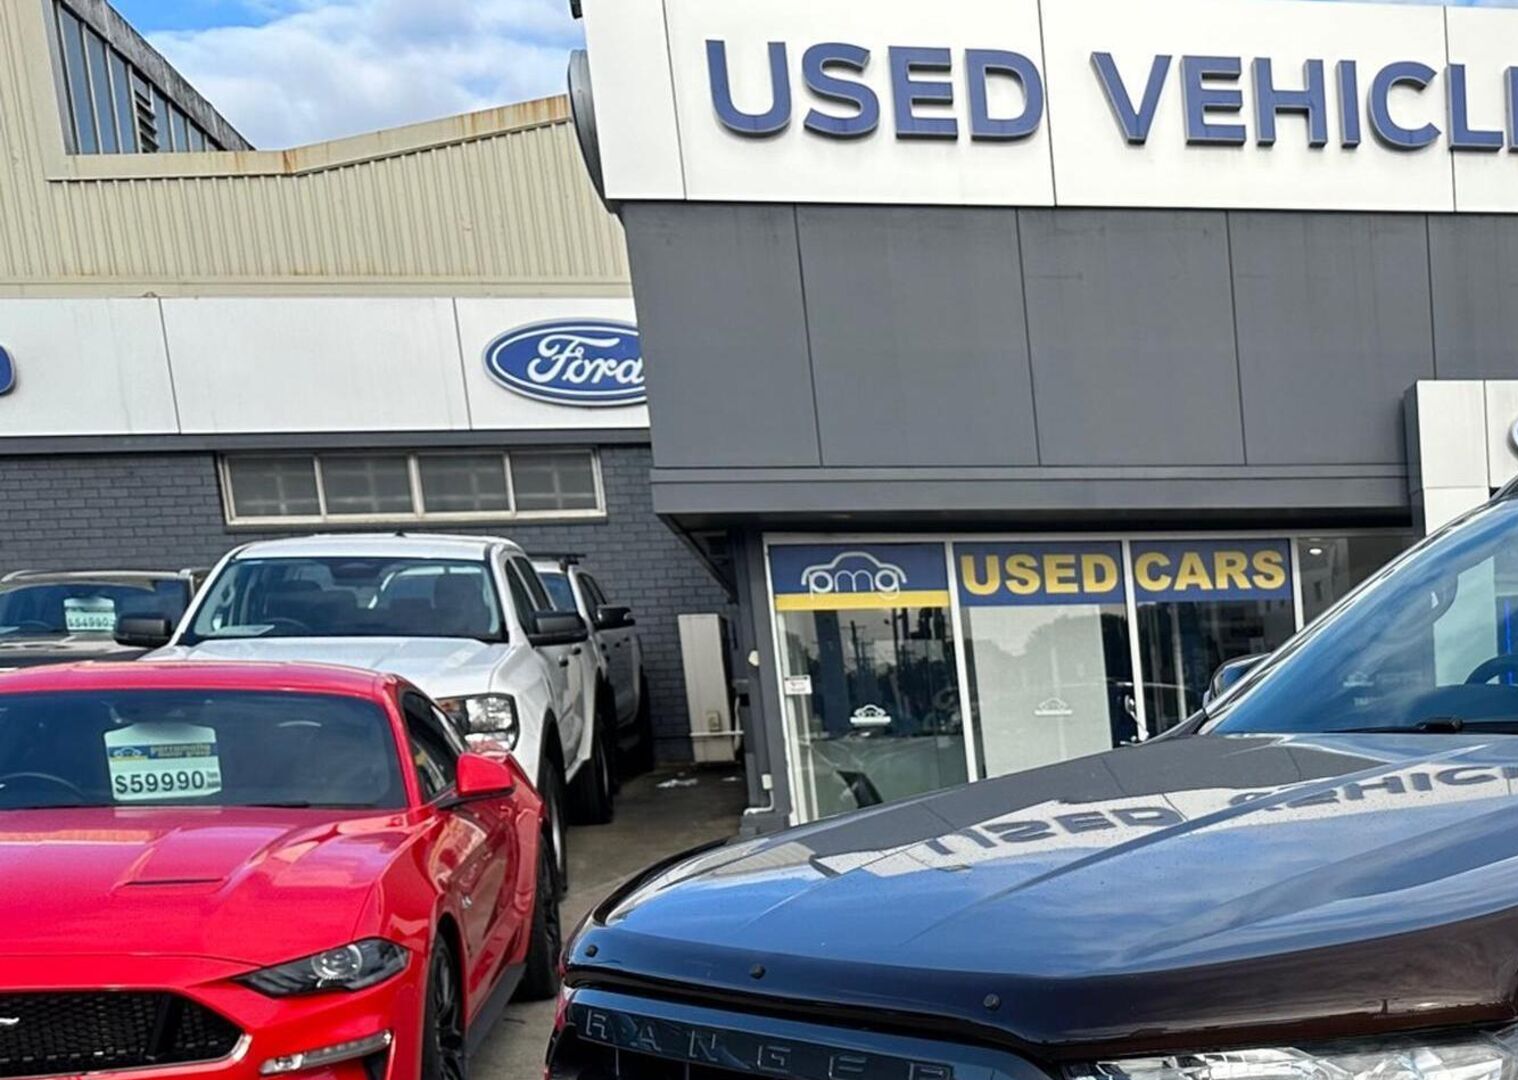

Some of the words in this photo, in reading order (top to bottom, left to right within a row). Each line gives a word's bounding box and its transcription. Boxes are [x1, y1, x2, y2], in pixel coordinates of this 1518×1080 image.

[705, 39, 1044, 142] USED
[959, 554, 1118, 596] USED
[1134, 550, 1287, 592] CARS
[115, 770, 205, 794] $59990
